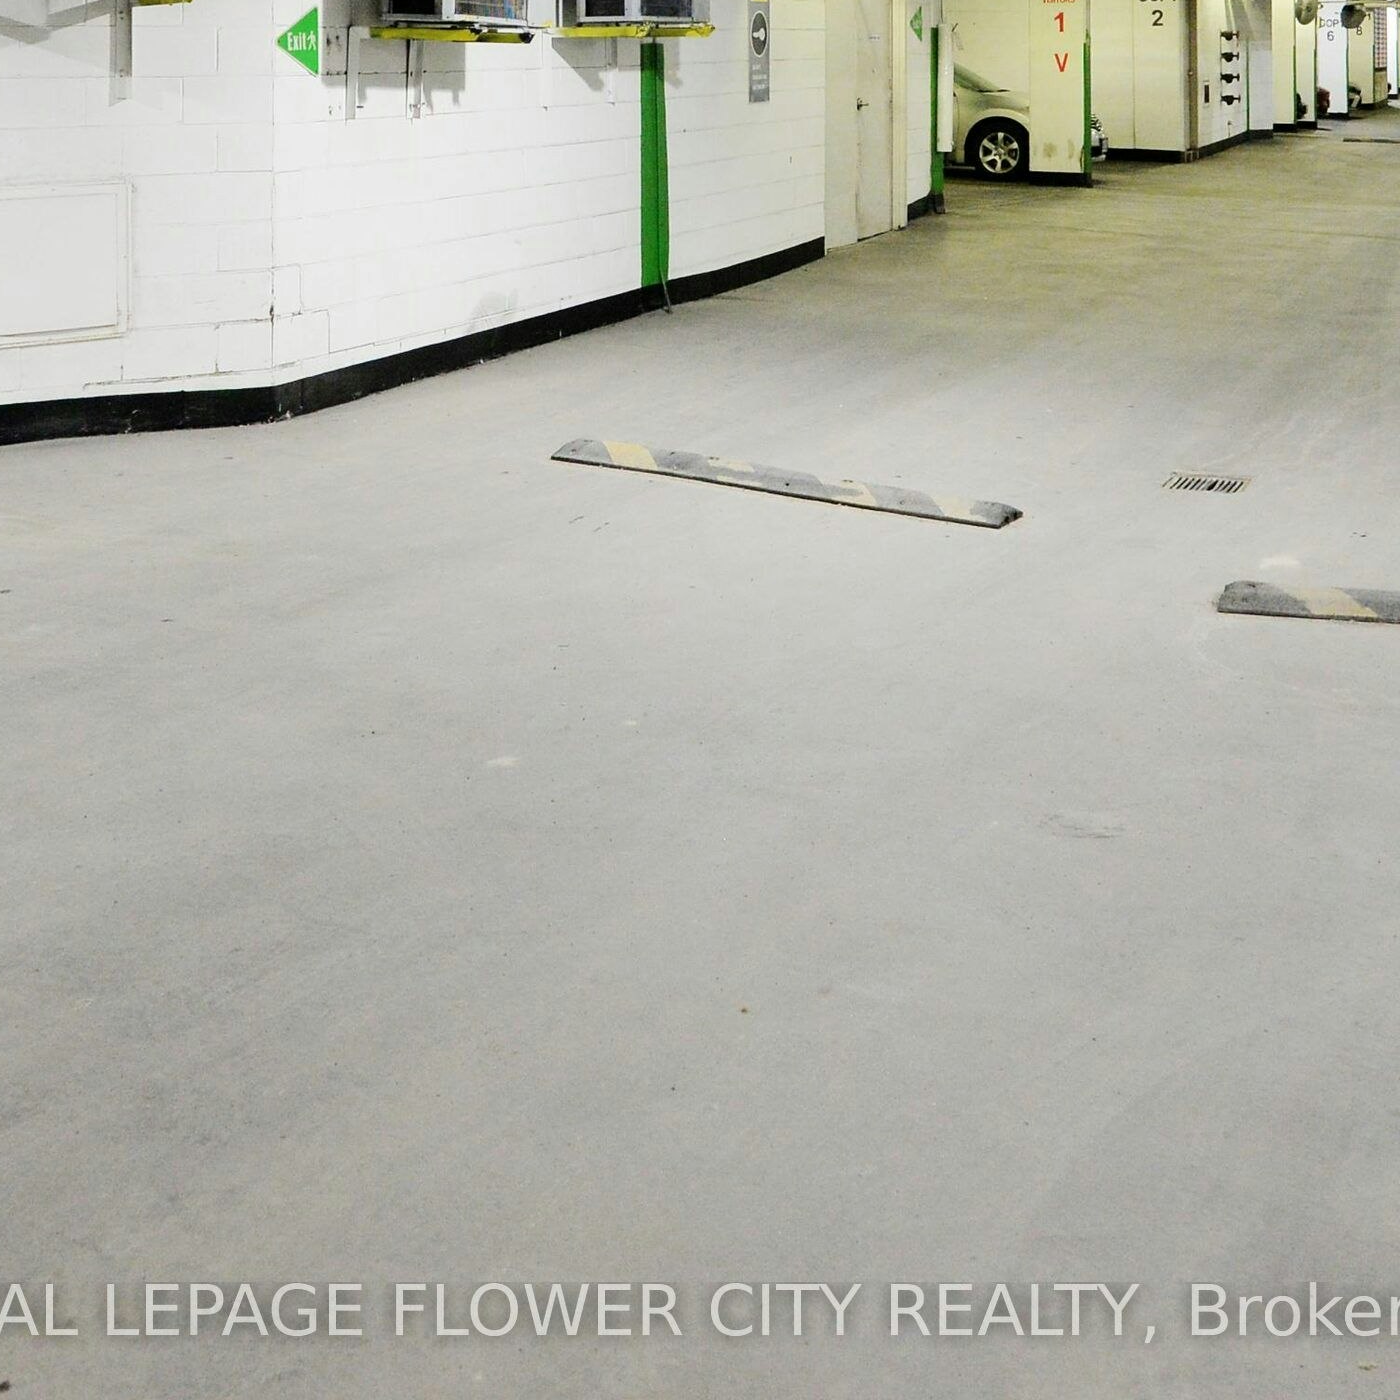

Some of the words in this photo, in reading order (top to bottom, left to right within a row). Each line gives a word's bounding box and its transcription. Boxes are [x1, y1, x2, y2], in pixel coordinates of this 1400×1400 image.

[1054, 12, 1064, 32] 1
[1152, 10, 1164, 26] 2
[287, 32, 307, 51] Exit
[1327, 31, 1335, 41] 6
[1054, 53, 1068, 72] V
